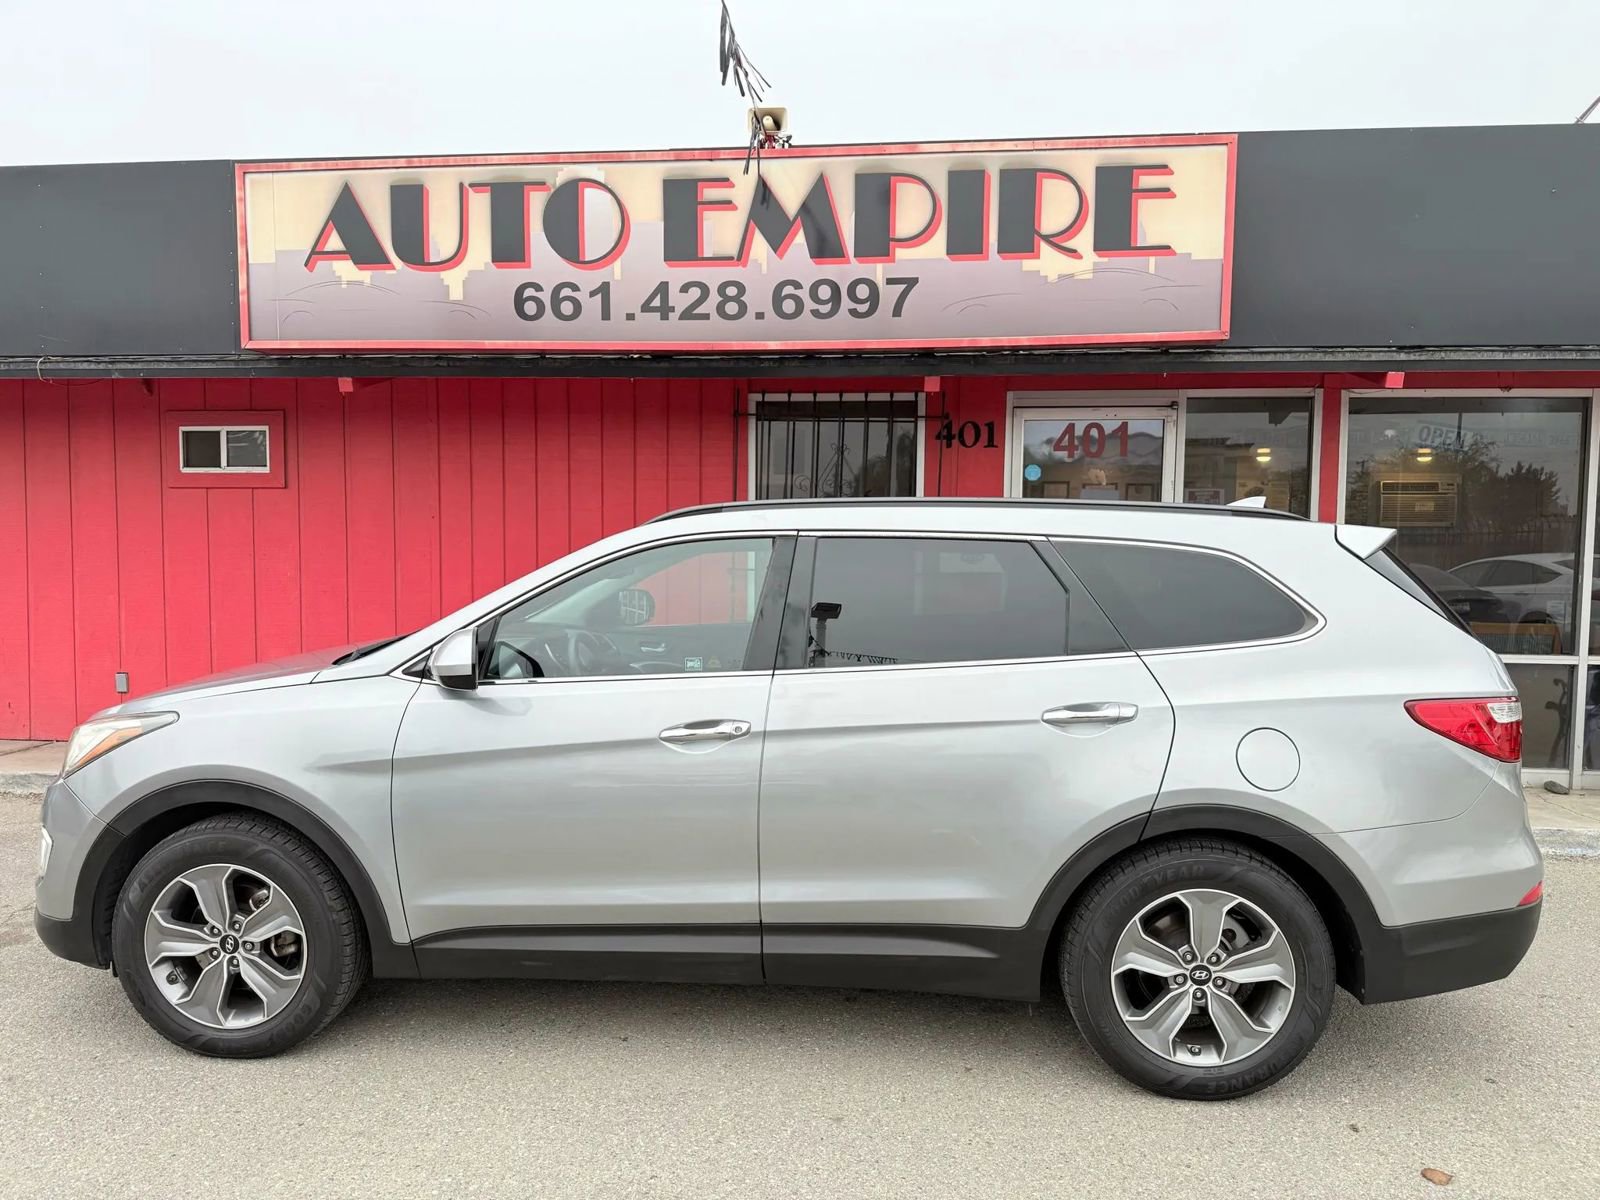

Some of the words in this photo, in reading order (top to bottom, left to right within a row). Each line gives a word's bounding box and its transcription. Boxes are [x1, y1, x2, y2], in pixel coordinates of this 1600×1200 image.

[304, 177, 631, 272] AUTO
[662, 165, 1176, 267] EMPIRE
[514, 278, 920, 321] 661.428.6997
[936, 419, 998, 449] 401
[1053, 421, 1129, 459] 401
